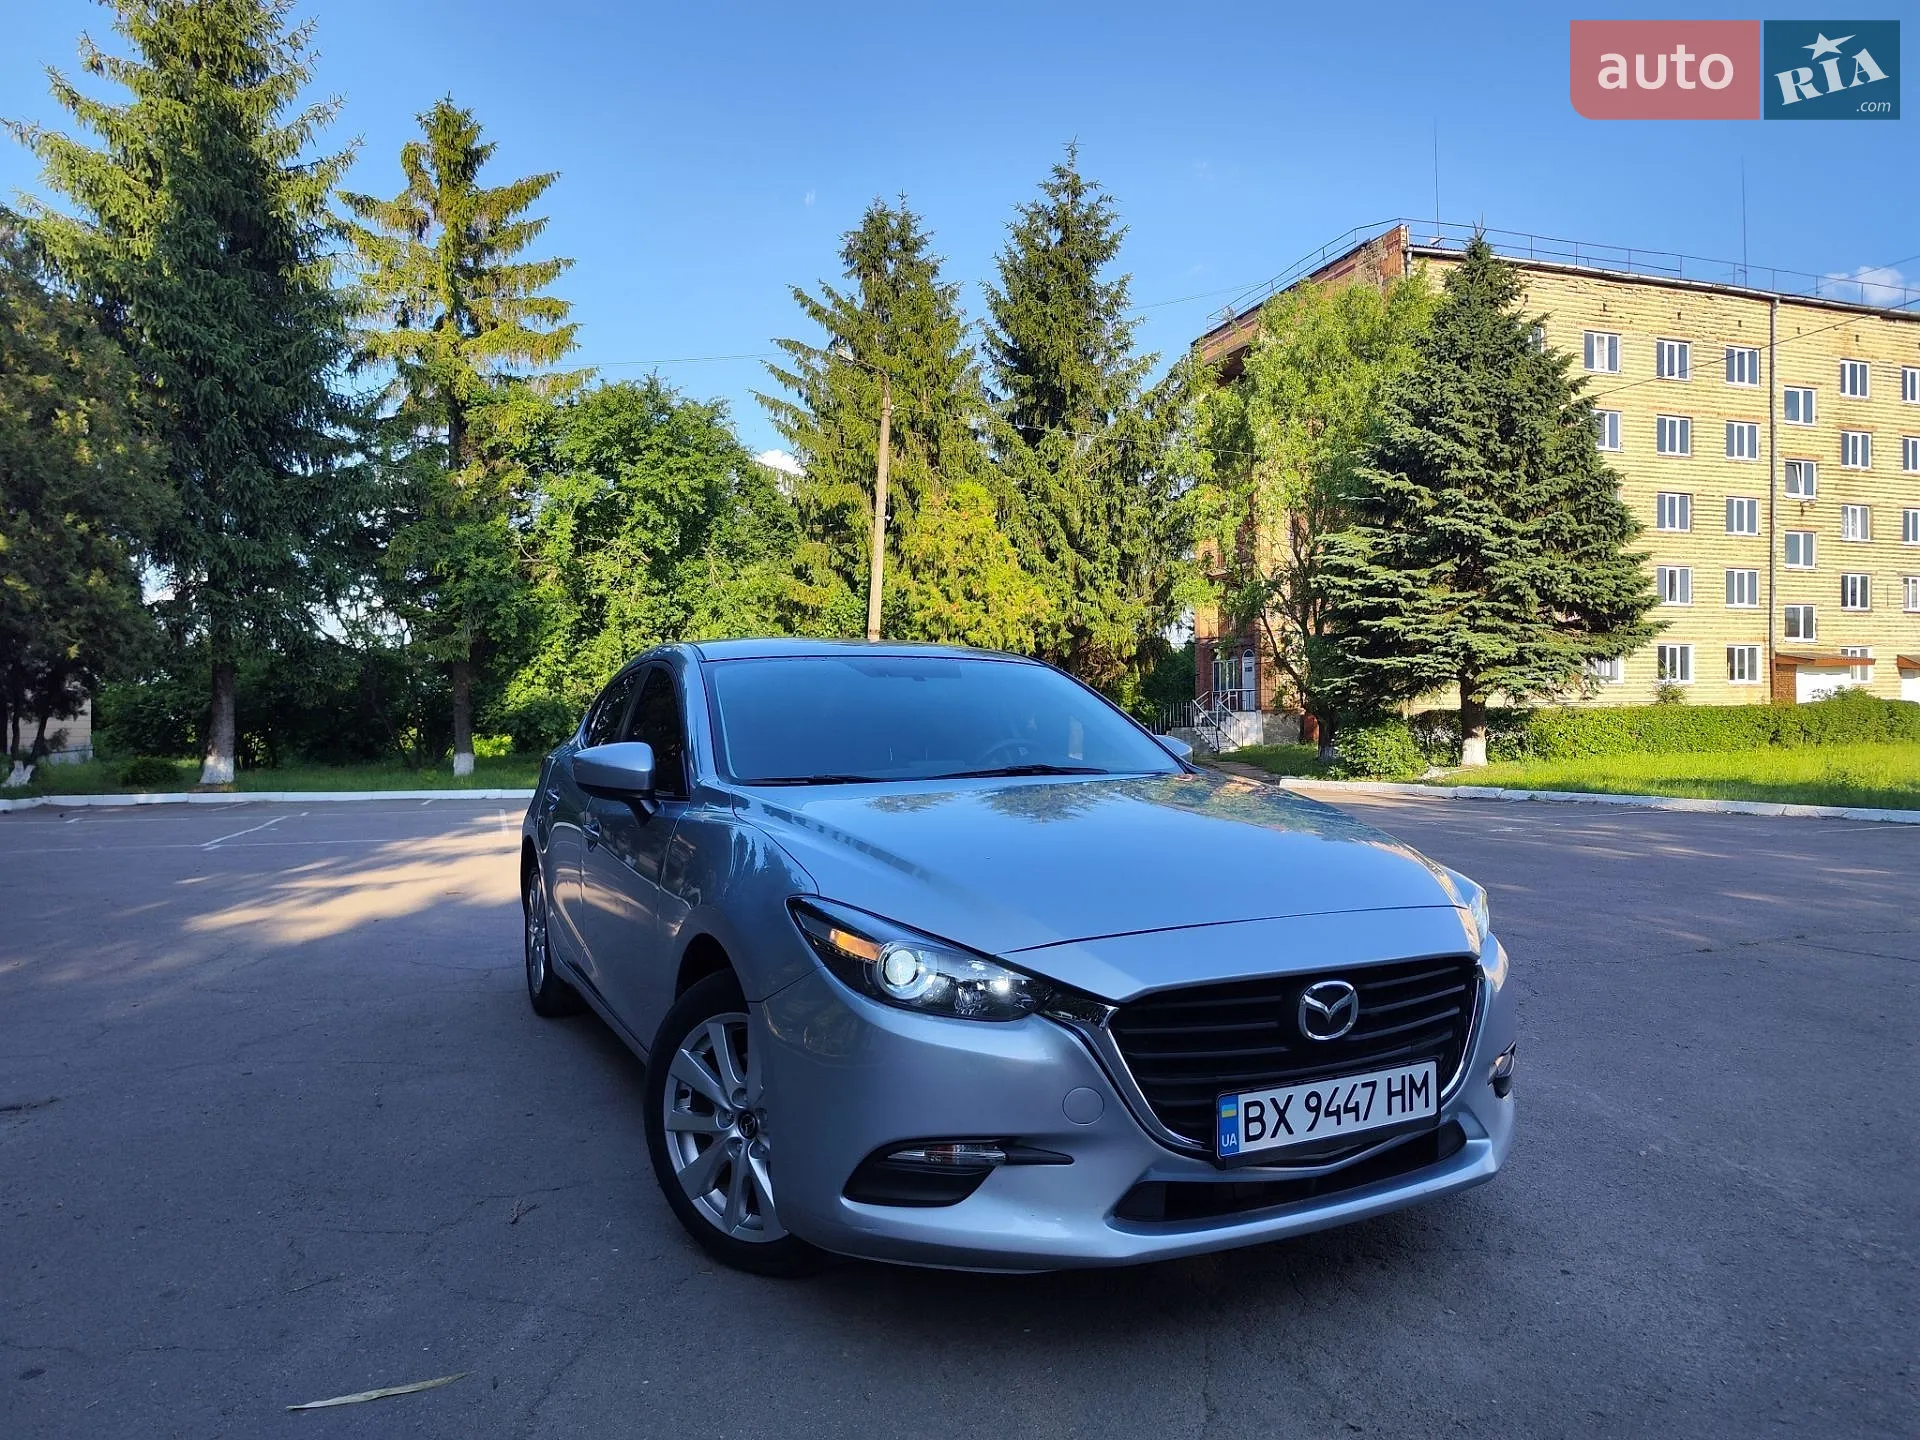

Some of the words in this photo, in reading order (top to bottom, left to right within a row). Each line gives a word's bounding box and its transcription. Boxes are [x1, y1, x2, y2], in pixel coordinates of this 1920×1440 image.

[1244, 1094, 1294, 1142] BX
[1304, 1080, 1377, 1132] 9447
[1386, 1070, 1429, 1116] HM
[1221, 1133, 1238, 1147] UA
